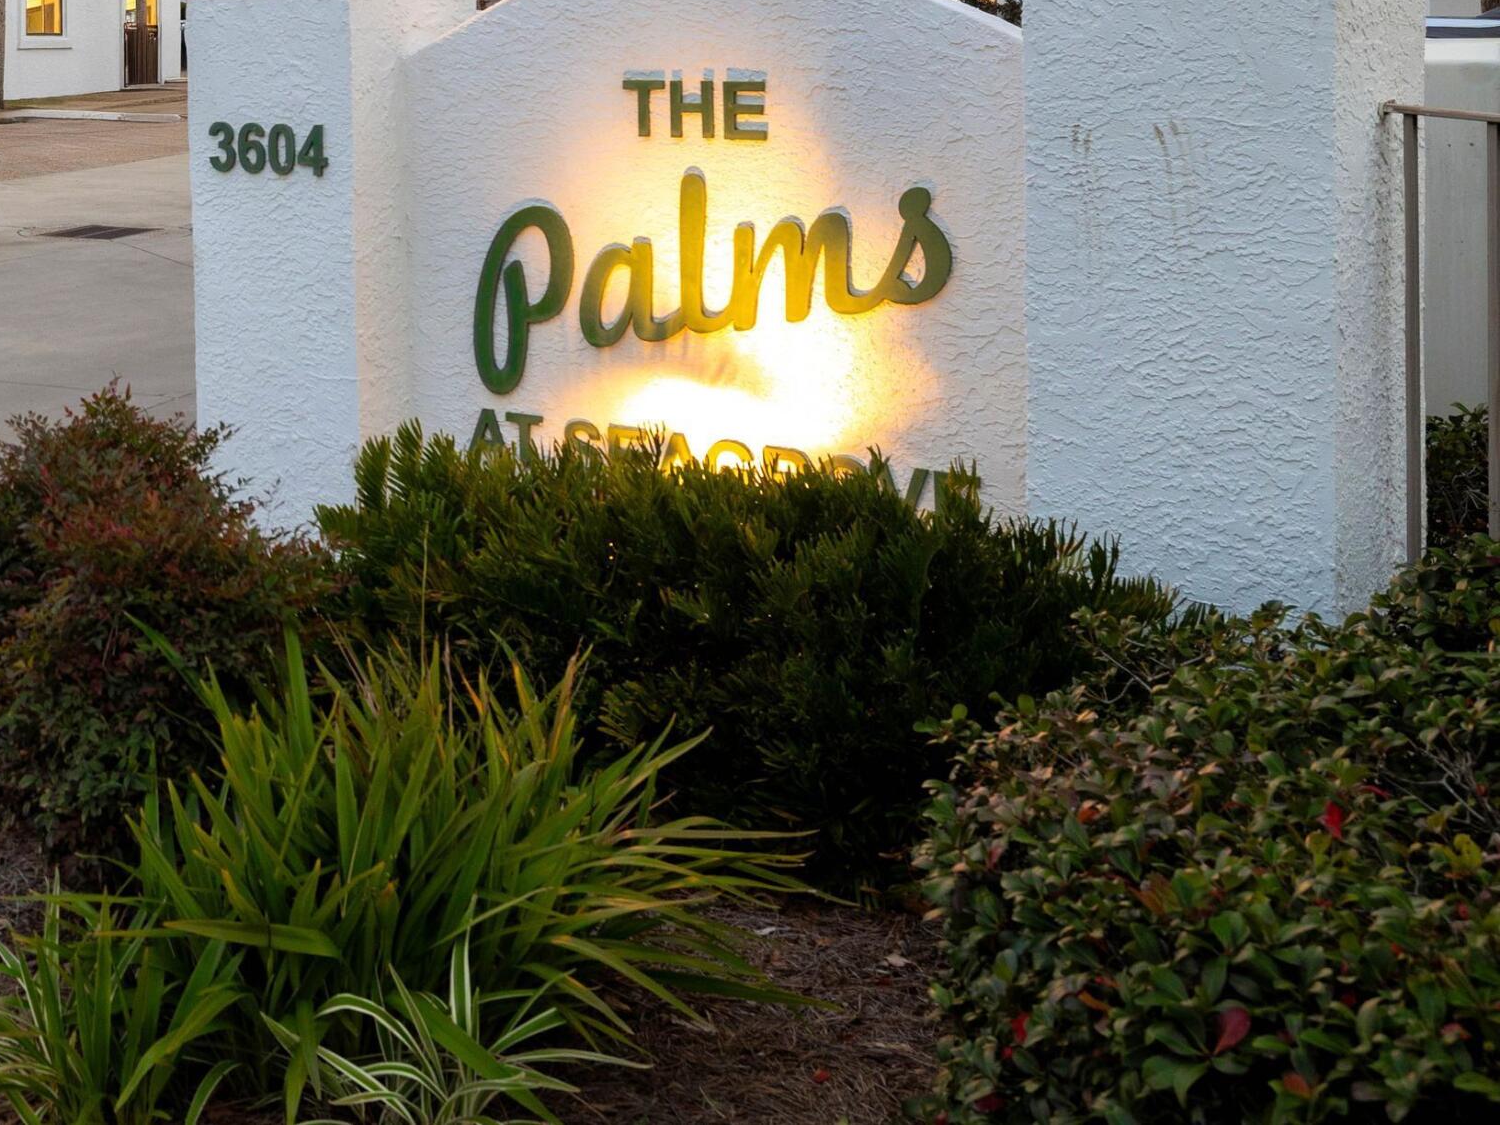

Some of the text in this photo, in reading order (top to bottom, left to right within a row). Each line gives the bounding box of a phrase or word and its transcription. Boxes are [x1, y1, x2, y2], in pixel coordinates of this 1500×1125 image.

[622, 71, 769, 140] THE
[209, 121, 329, 177] 3604
[472, 167, 954, 395] Palms
[467, 409, 544, 461] AT
